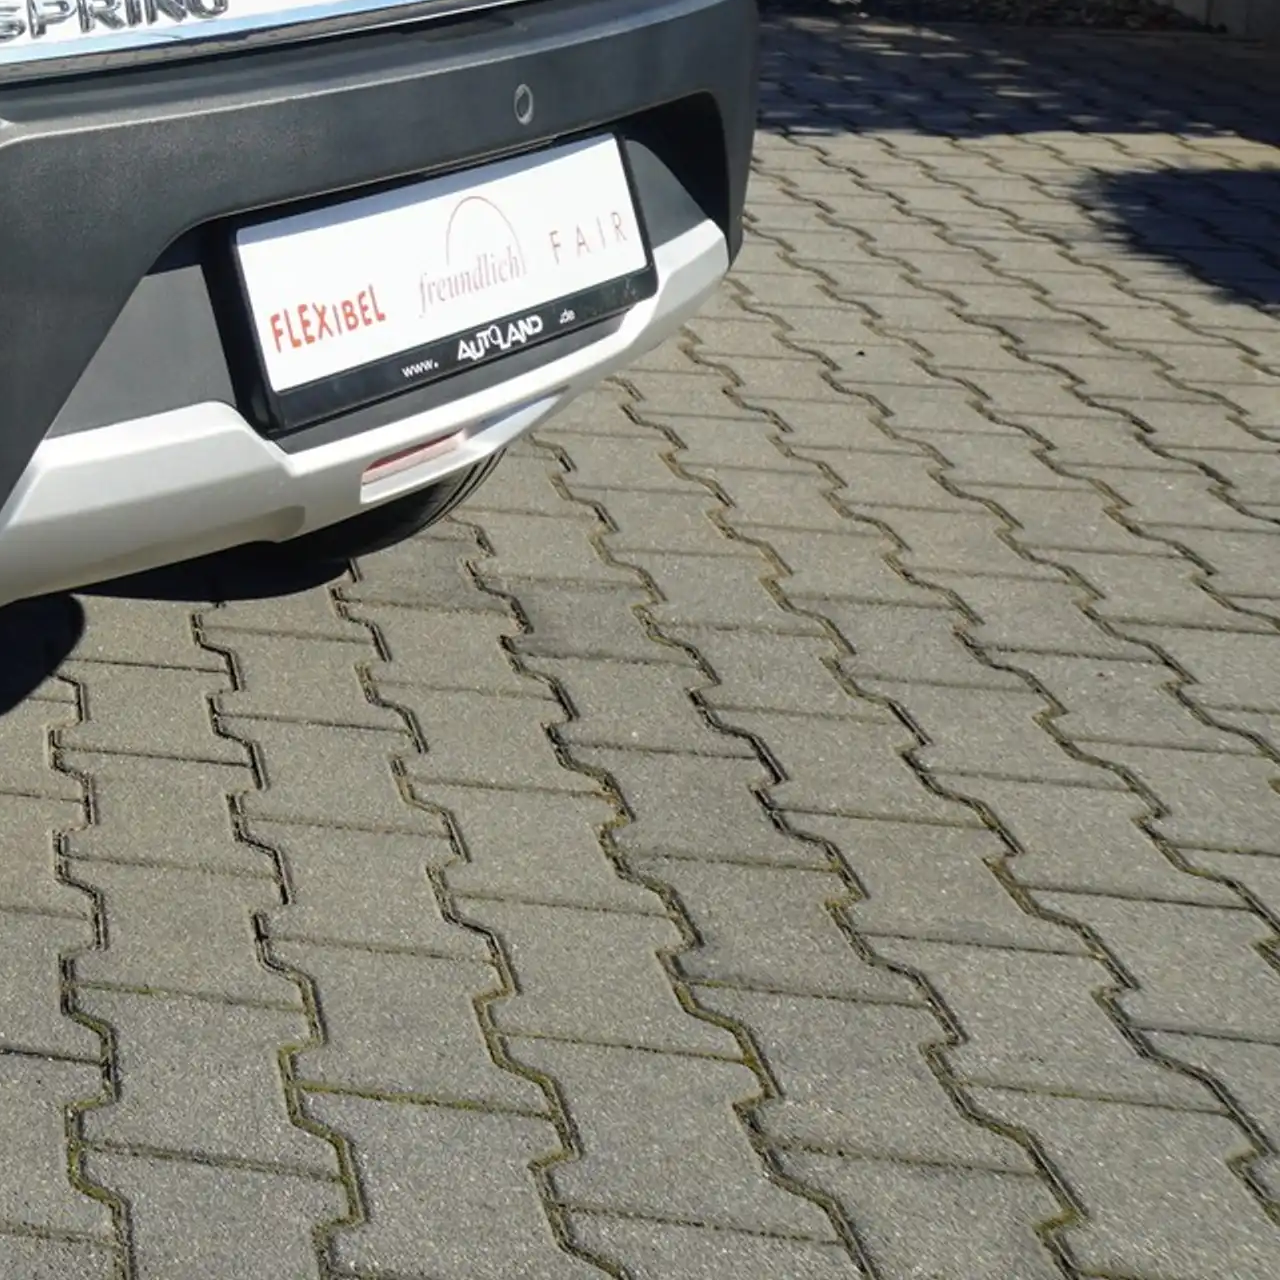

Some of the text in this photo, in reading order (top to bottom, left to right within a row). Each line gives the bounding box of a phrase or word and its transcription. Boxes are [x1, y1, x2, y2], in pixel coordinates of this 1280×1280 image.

[269, 211, 628, 354] FLEXIBEL freundlich FAIR
[401, 358, 439, 379] www.
[456, 314, 544, 361] AUTOLAND
